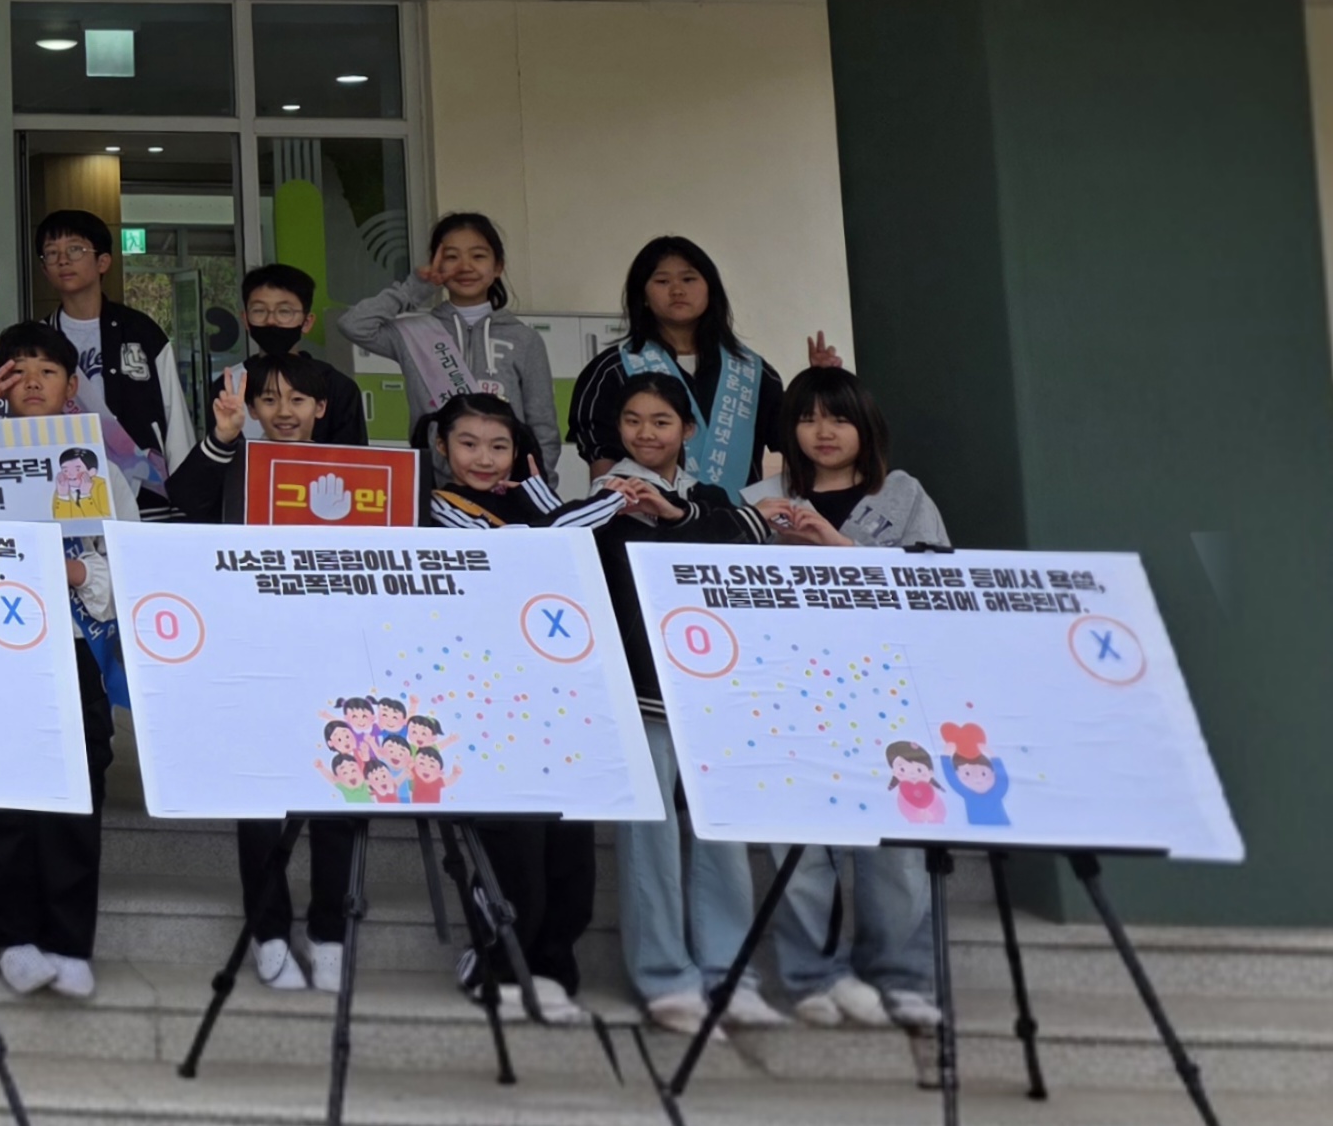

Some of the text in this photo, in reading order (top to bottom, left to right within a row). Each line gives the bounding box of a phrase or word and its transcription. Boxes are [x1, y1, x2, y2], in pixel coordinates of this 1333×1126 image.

[215, 550, 286, 571] 사소한
[416, 549, 491, 571] 장난은
[255, 574, 465, 595] 학교폭력이 아니다.
[891, 566, 965, 588] 대화방
[969, 568, 1041, 590] 등에서
[702, 587, 1090, 614] 따돌림도 학교폭력 범죄에 해당된다.
